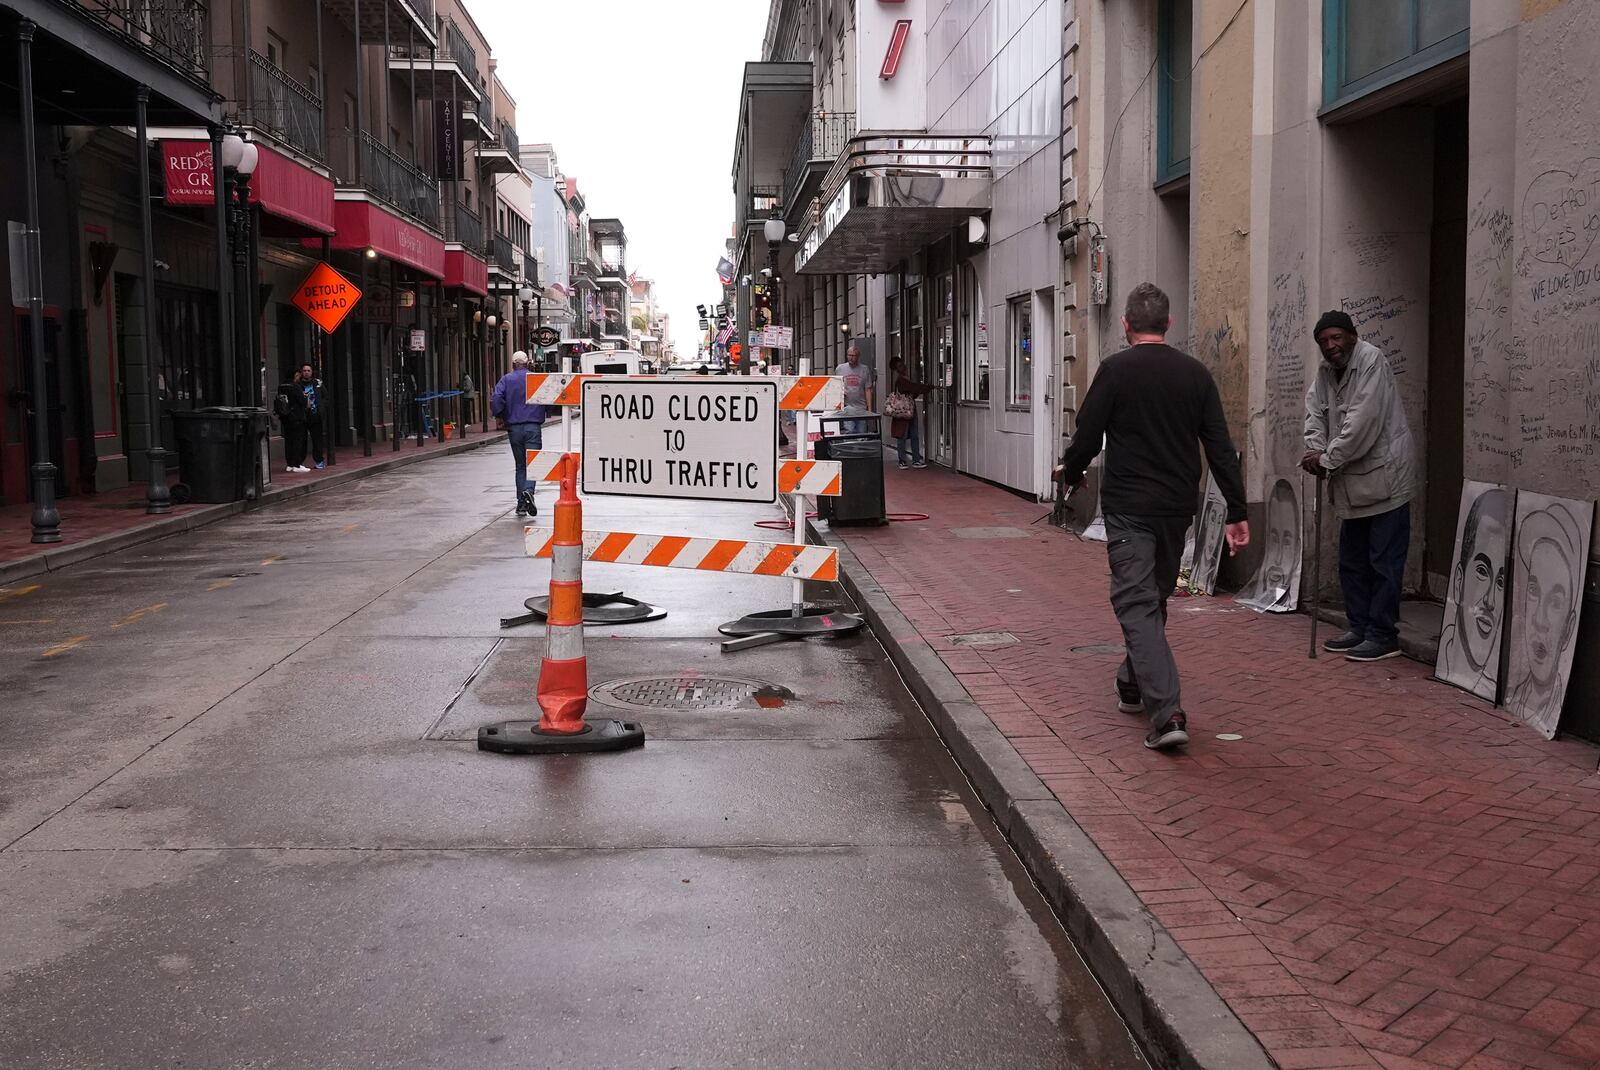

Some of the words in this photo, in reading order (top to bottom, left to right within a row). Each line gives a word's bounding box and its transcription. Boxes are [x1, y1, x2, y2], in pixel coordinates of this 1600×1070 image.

[170, 156, 199, 170] RED
[187, 172, 211, 186] GR
[304, 284, 346, 297] DETOUR
[1531, 279, 1545, 303] WE
[1548, 273, 1569, 296] LOVE
[1572, 268, 1591, 292] YOU
[308, 298, 347, 311] AHEAD
[601, 394, 654, 420] ROAD
[668, 395, 758, 422] CLOSED
[663, 429, 685, 451] TO
[599, 457, 652, 485] THRU
[665, 460, 758, 489] TRAFFIC
